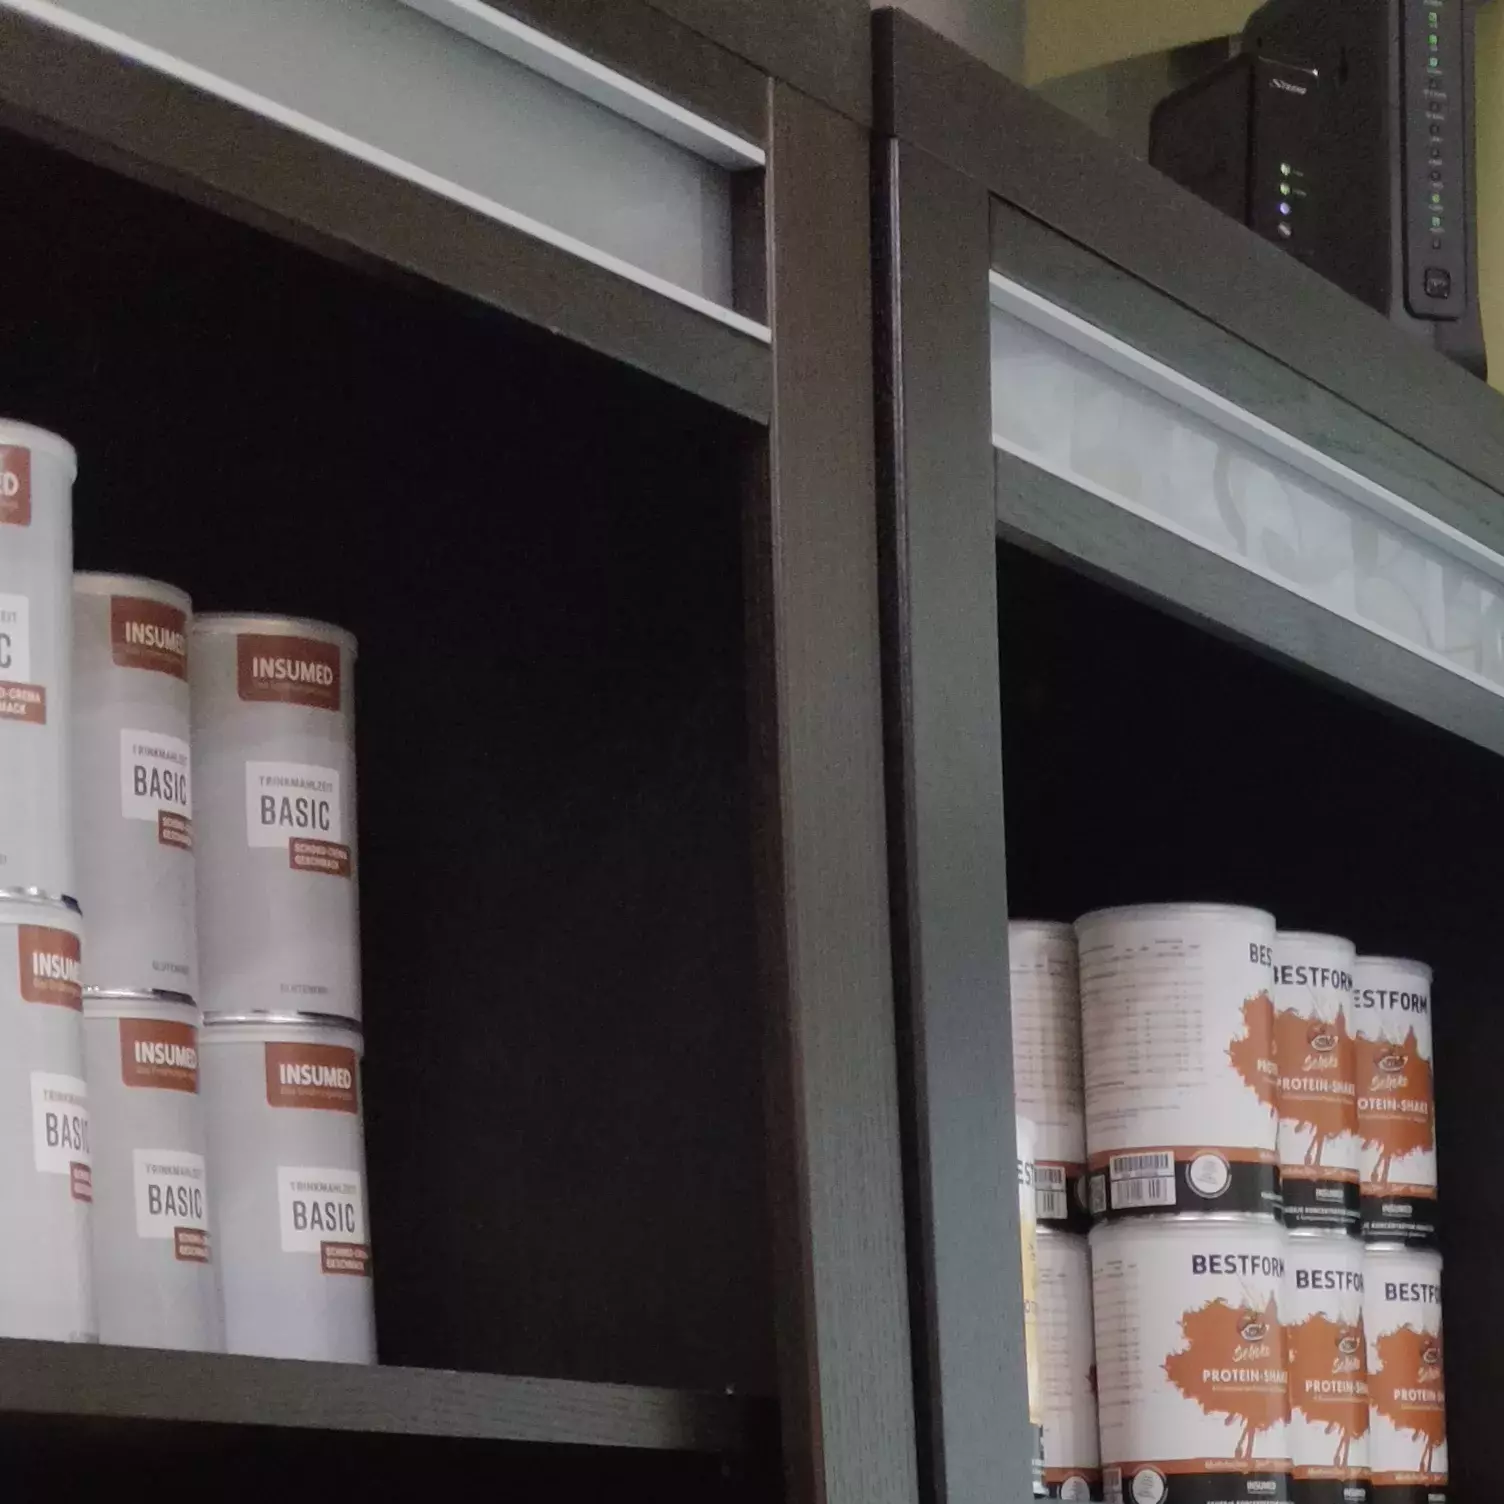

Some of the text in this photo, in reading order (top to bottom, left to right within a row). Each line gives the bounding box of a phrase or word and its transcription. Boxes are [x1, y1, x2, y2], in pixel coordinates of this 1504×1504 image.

[252, 656, 333, 686] INSUMED
[134, 765, 187, 806] BASIC
[260, 795, 331, 831] BASIC
[279, 1064, 352, 1090] INSUMED
[148, 1184, 203, 1219] BASIC
[292, 1200, 356, 1233] BASIC
